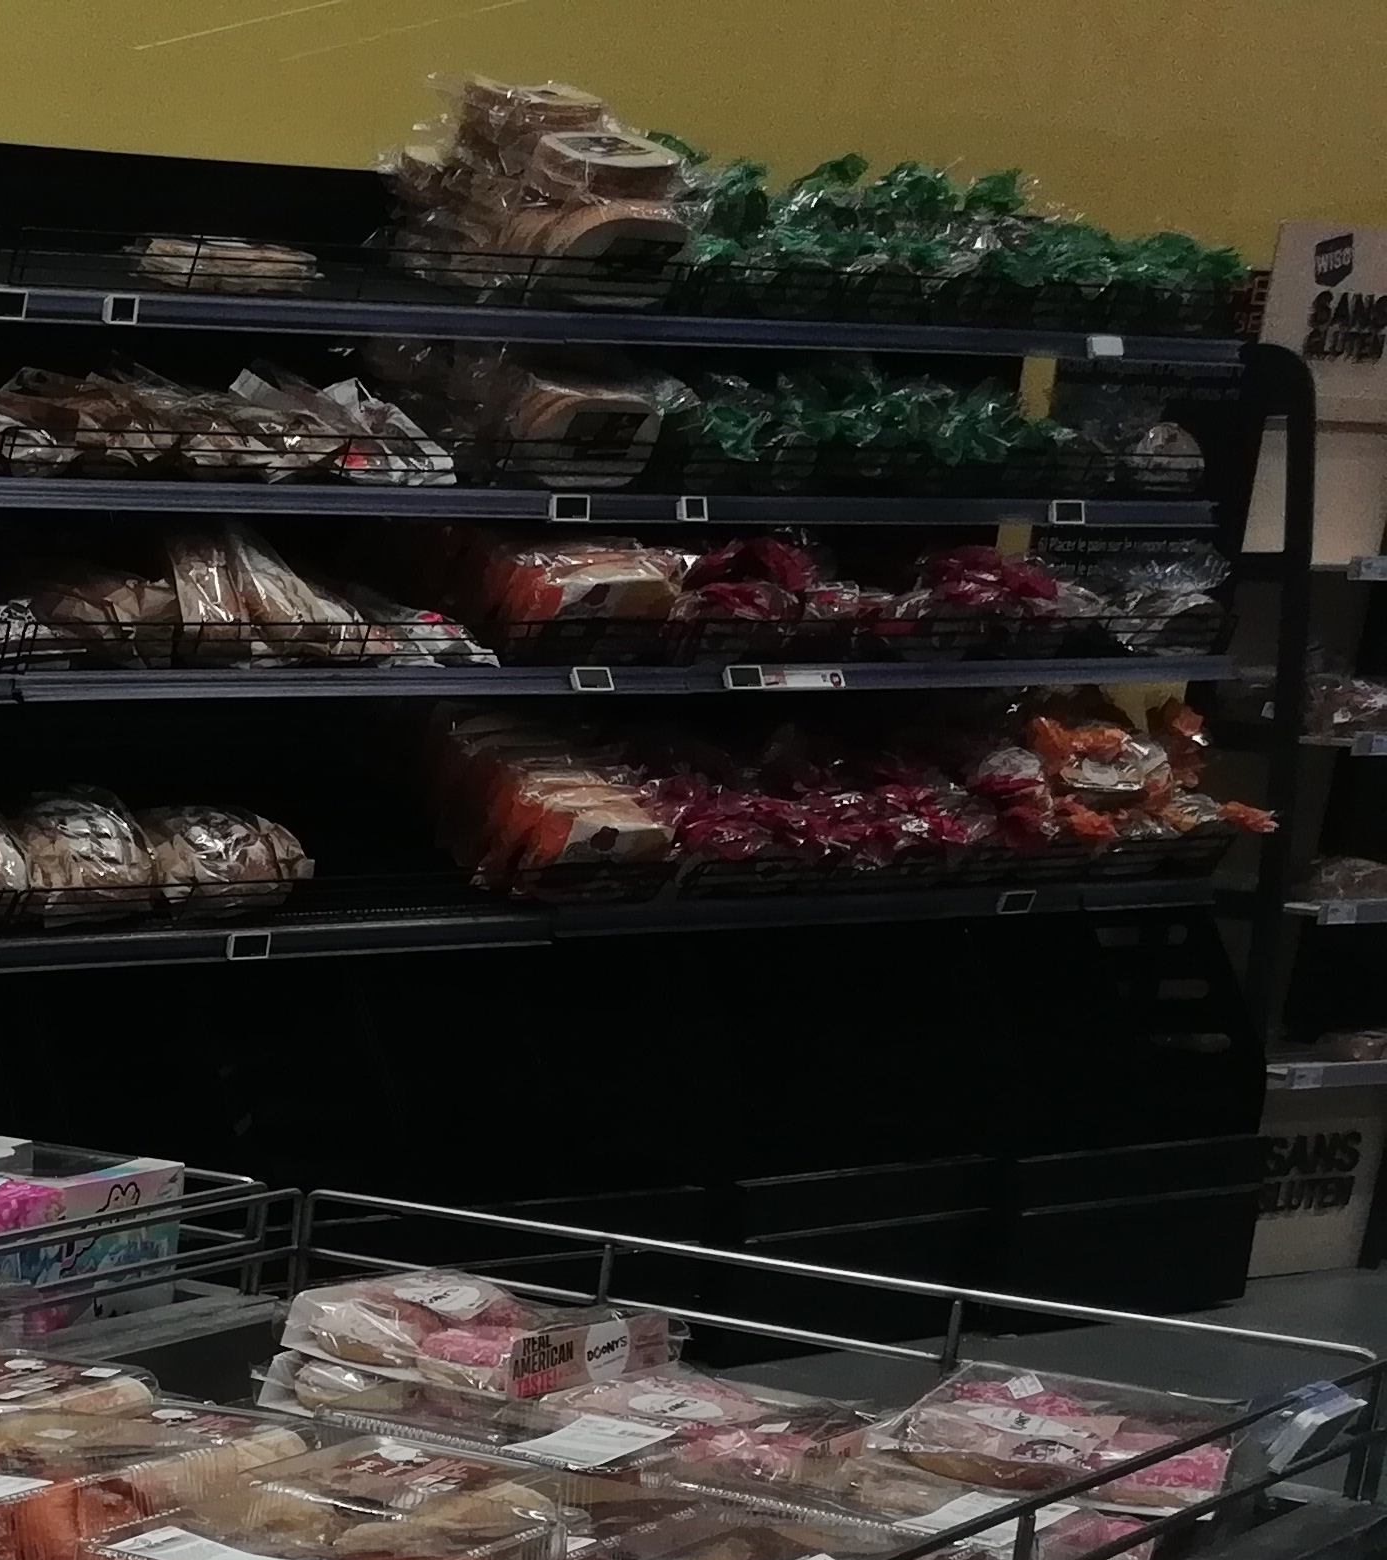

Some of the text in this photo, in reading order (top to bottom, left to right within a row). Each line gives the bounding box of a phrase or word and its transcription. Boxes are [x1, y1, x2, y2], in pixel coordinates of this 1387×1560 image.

[1309, 291, 1387, 329] SANS
[512, 1340, 575, 1380] AMERICAN
[522, 1334, 553, 1356] REAL
[514, 1367, 560, 1398] TASTE!
